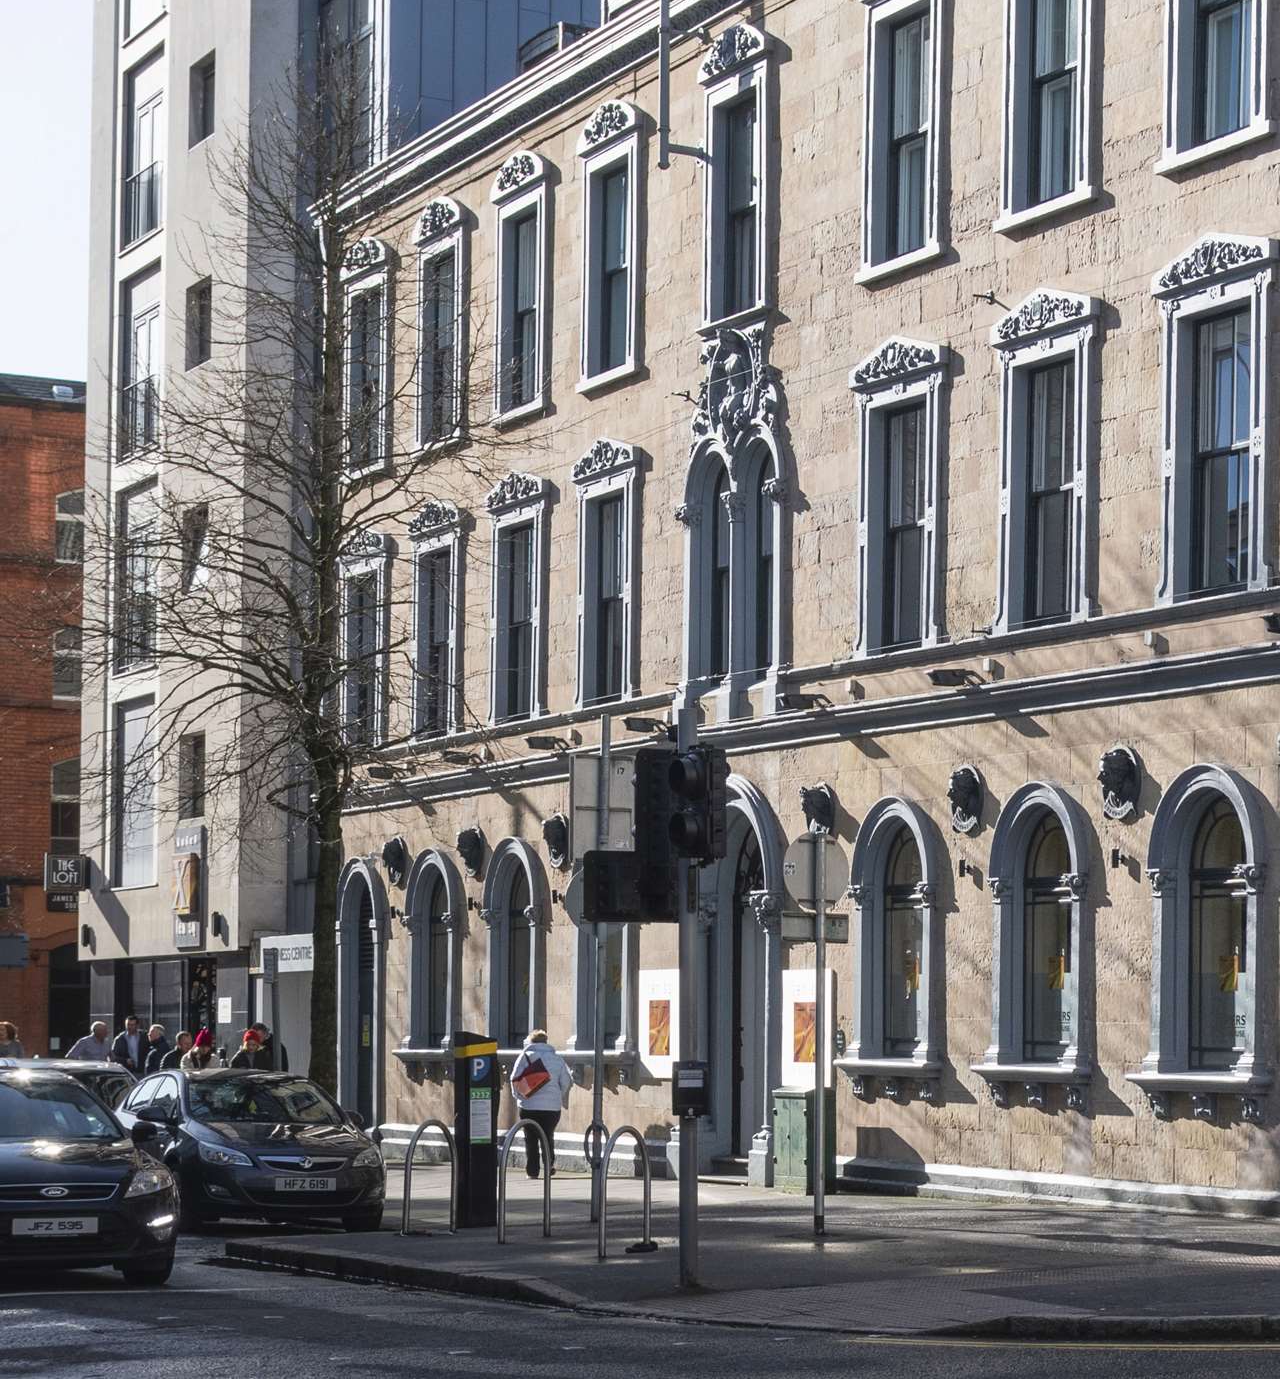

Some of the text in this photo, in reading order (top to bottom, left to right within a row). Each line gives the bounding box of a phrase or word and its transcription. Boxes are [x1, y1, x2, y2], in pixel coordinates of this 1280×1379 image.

[57, 859, 75, 871] THE
[52, 871, 79, 884] LOFT
[474, 1058, 485, 1077] P
[284, 1179, 329, 1189] HFZ 6191
[27, 1220, 84, 1231] JFZ 535
